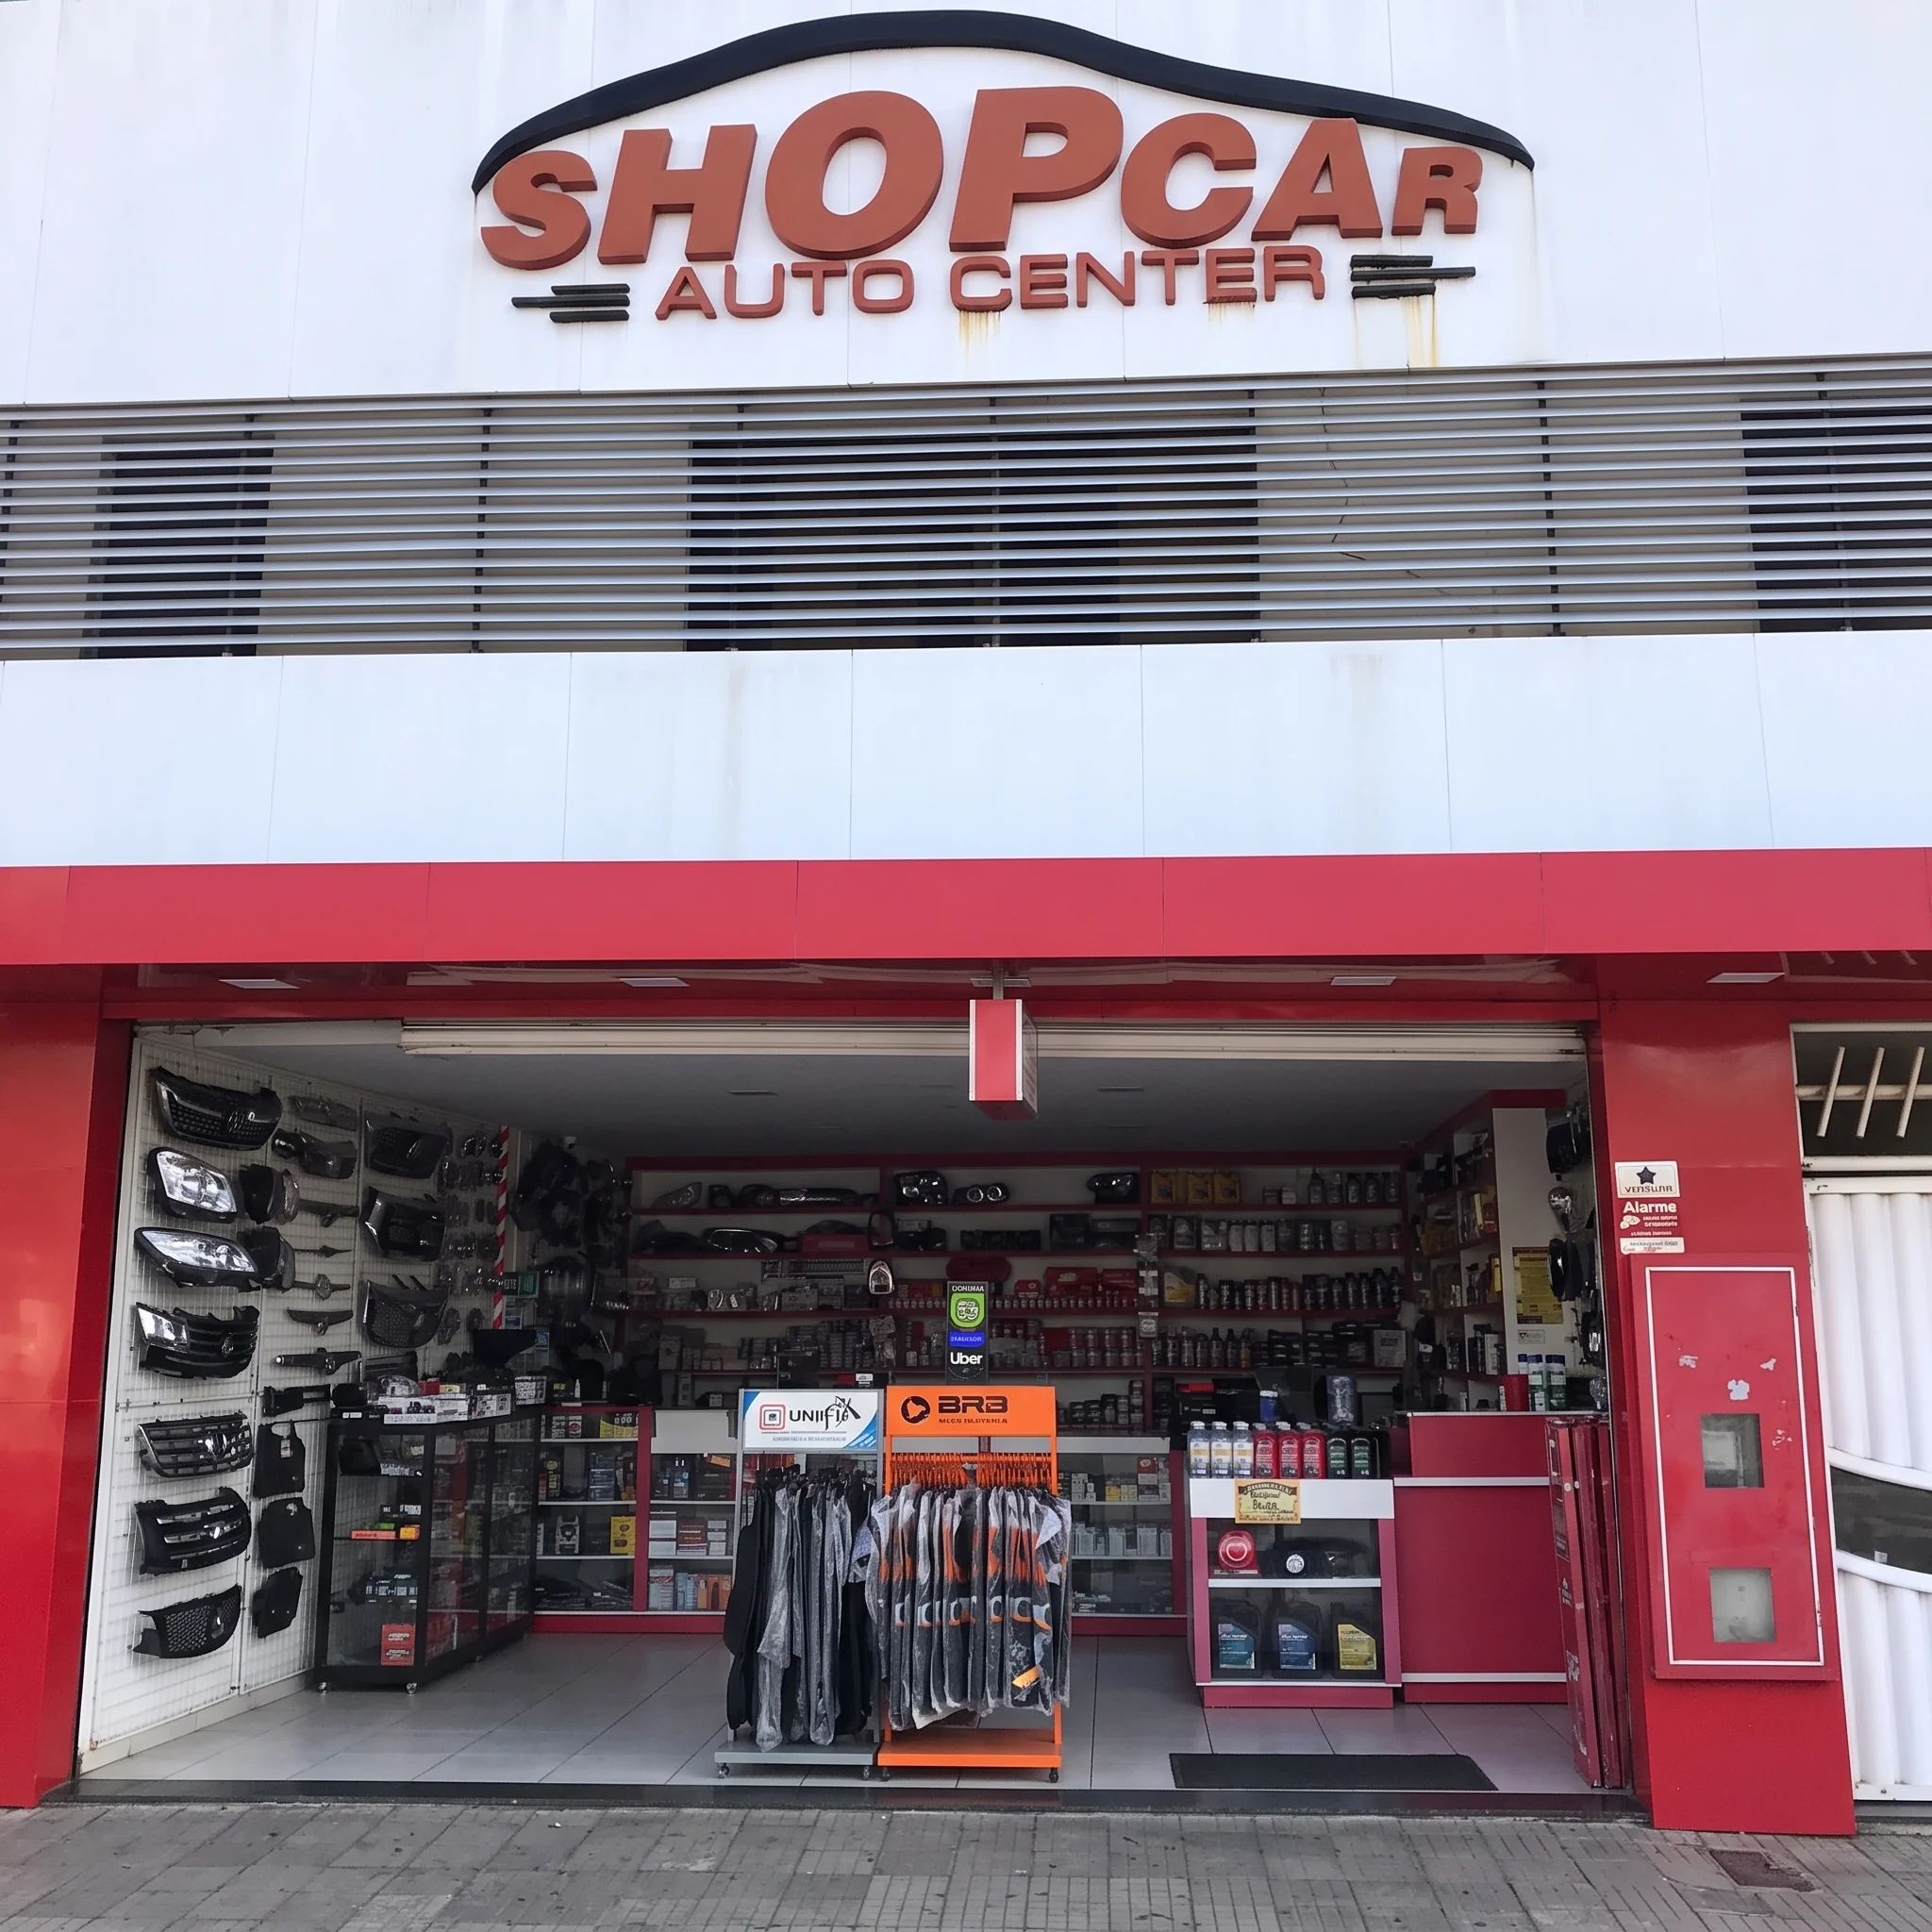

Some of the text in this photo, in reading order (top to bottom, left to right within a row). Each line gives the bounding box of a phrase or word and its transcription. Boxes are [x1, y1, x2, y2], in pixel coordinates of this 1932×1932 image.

[480, 86, 1483, 271] SHOPCAR
[655, 244, 1325, 320] AUTO CENTER
[1623, 1200, 1677, 1214] Alarme
[950, 1352, 983, 1365] Uber
[938, 1395, 1008, 1414] BRB
